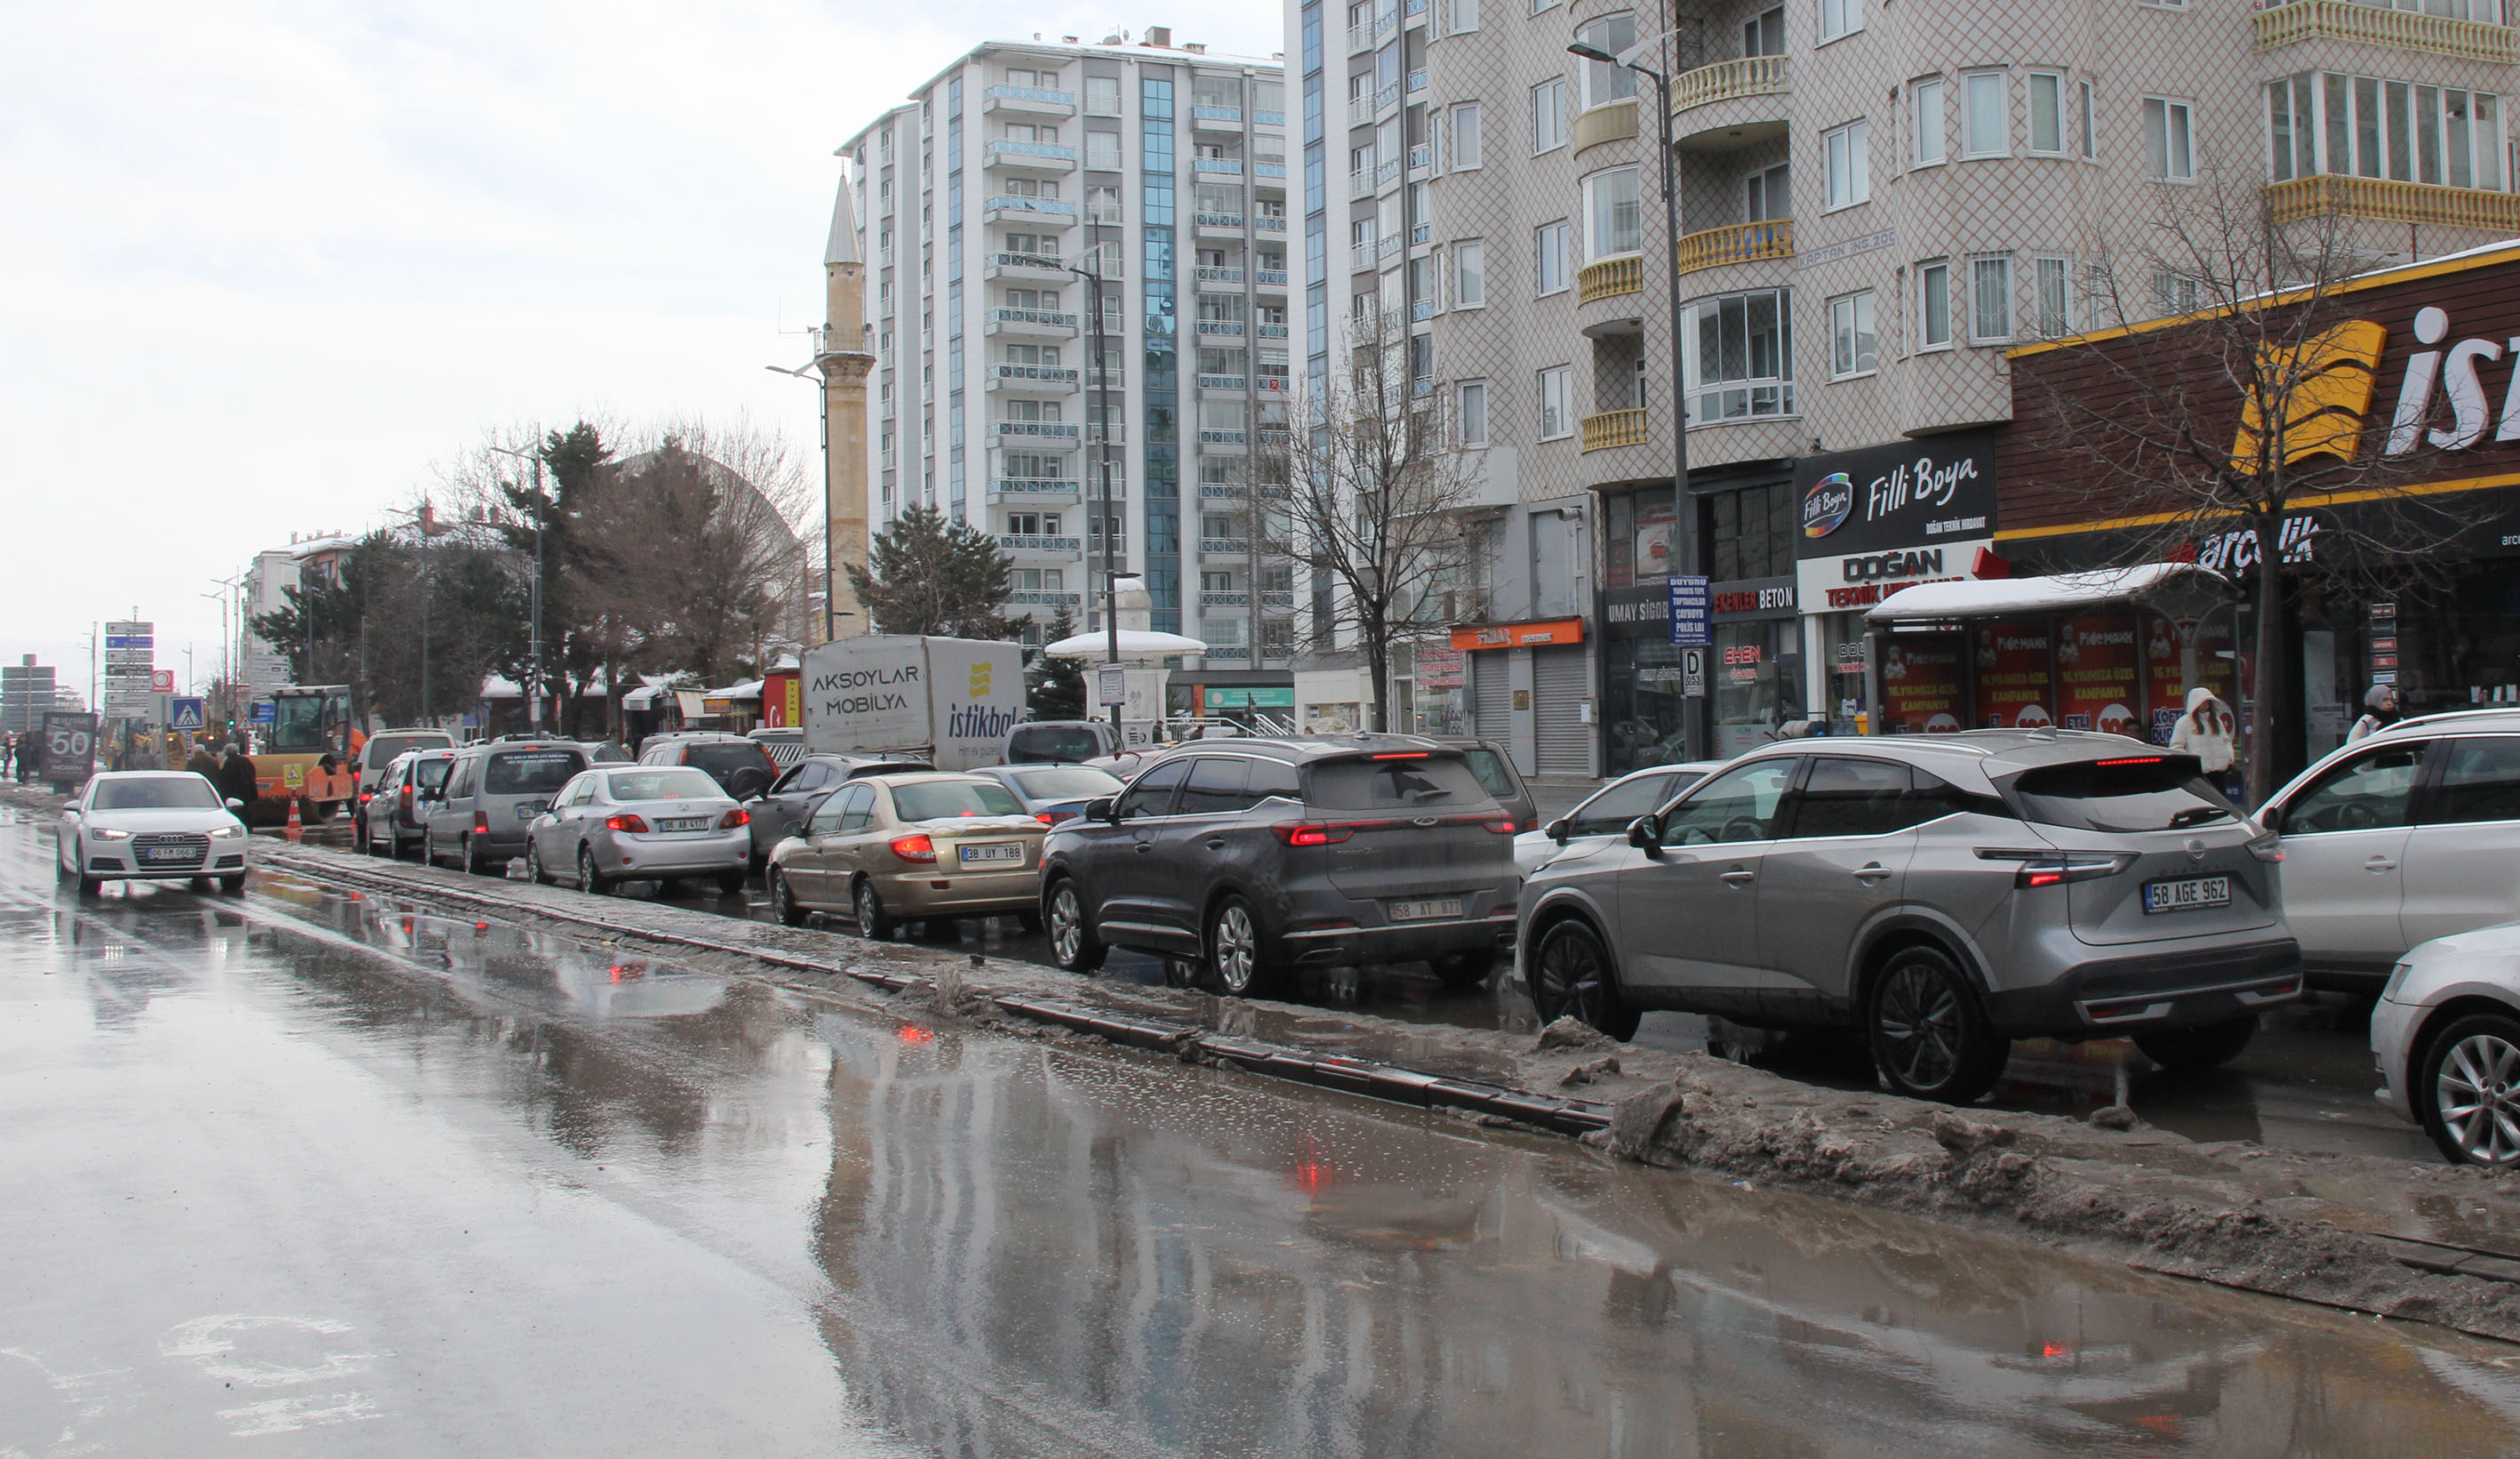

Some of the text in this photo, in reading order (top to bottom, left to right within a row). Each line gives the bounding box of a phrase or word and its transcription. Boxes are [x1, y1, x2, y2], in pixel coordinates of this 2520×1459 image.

[1799, 245, 1845, 267] KAPTAN
[1868, 457, 1978, 521] Filli Boya
[1804, 492, 1847, 521] Filli Boya
[1843, 549, 1942, 581] DOĞAN
[1715, 587, 1793, 612] EKENLER BETON
[1825, 581, 1881, 608] TEKNİK
[1609, 604, 1637, 622] UMAY
[1676, 621, 1693, 632] POLİS
[1687, 652, 1699, 675] D
[2113, 667, 2134, 680] ÖZEL
[812, 666, 918, 692] AKSOYLAR
[1686, 676, 1700, 684] 053
[2028, 671, 2048, 685] ÖZEL
[1992, 689, 2040, 702] KAMPANYA
[2074, 686, 2126, 700] KAMPANYA
[827, 693, 907, 716] MOBİLYA
[1900, 700, 1949, 712] KAMPANYA
[51, 731, 89, 755] 50
[691, 819, 707, 828] 4177
[968, 847, 1020, 859] 38 UY 188
[2153, 886, 2168, 905] 58
[2175, 882, 2197, 903] AGE
[2203, 879, 2226, 900] 962
[1397, 901, 1460, 918] 58 AT 877
